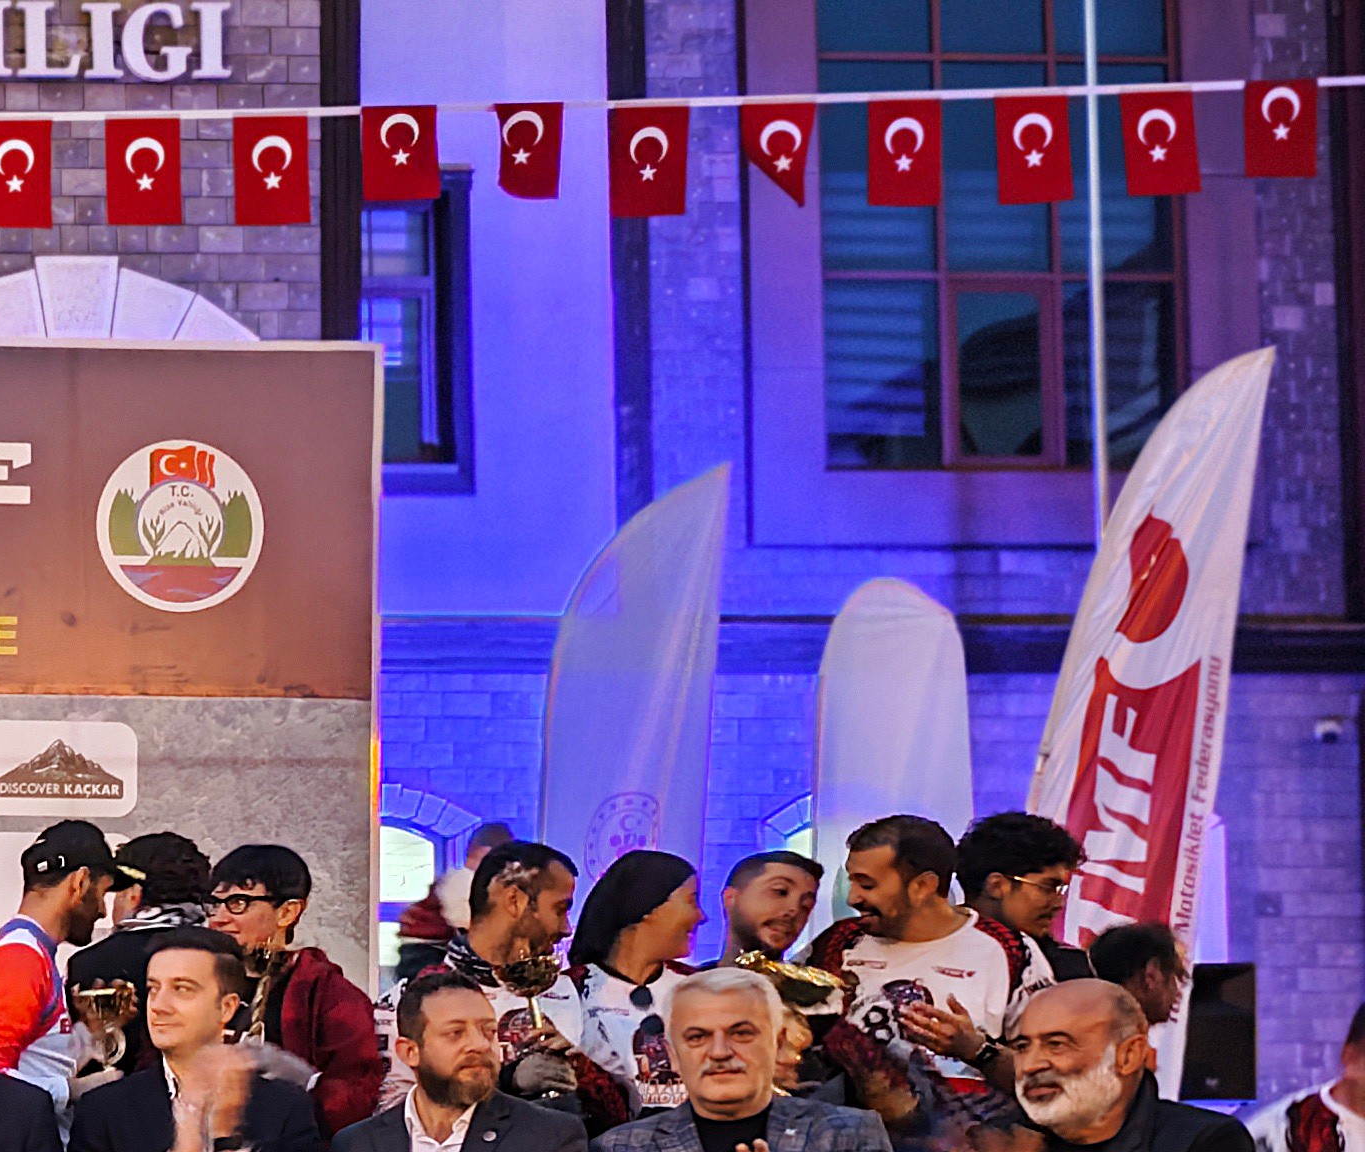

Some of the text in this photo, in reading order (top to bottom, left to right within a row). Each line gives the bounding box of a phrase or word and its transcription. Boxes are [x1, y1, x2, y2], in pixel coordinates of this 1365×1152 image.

[169, 485, 195, 497] T.C.
[0, 782, 119, 798] DISCOVER KAÇKAR
[1062, 693, 1157, 949] TMF
[1173, 812, 1205, 935] Motosiklet
[1190, 655, 1223, 804] Federasyonu
